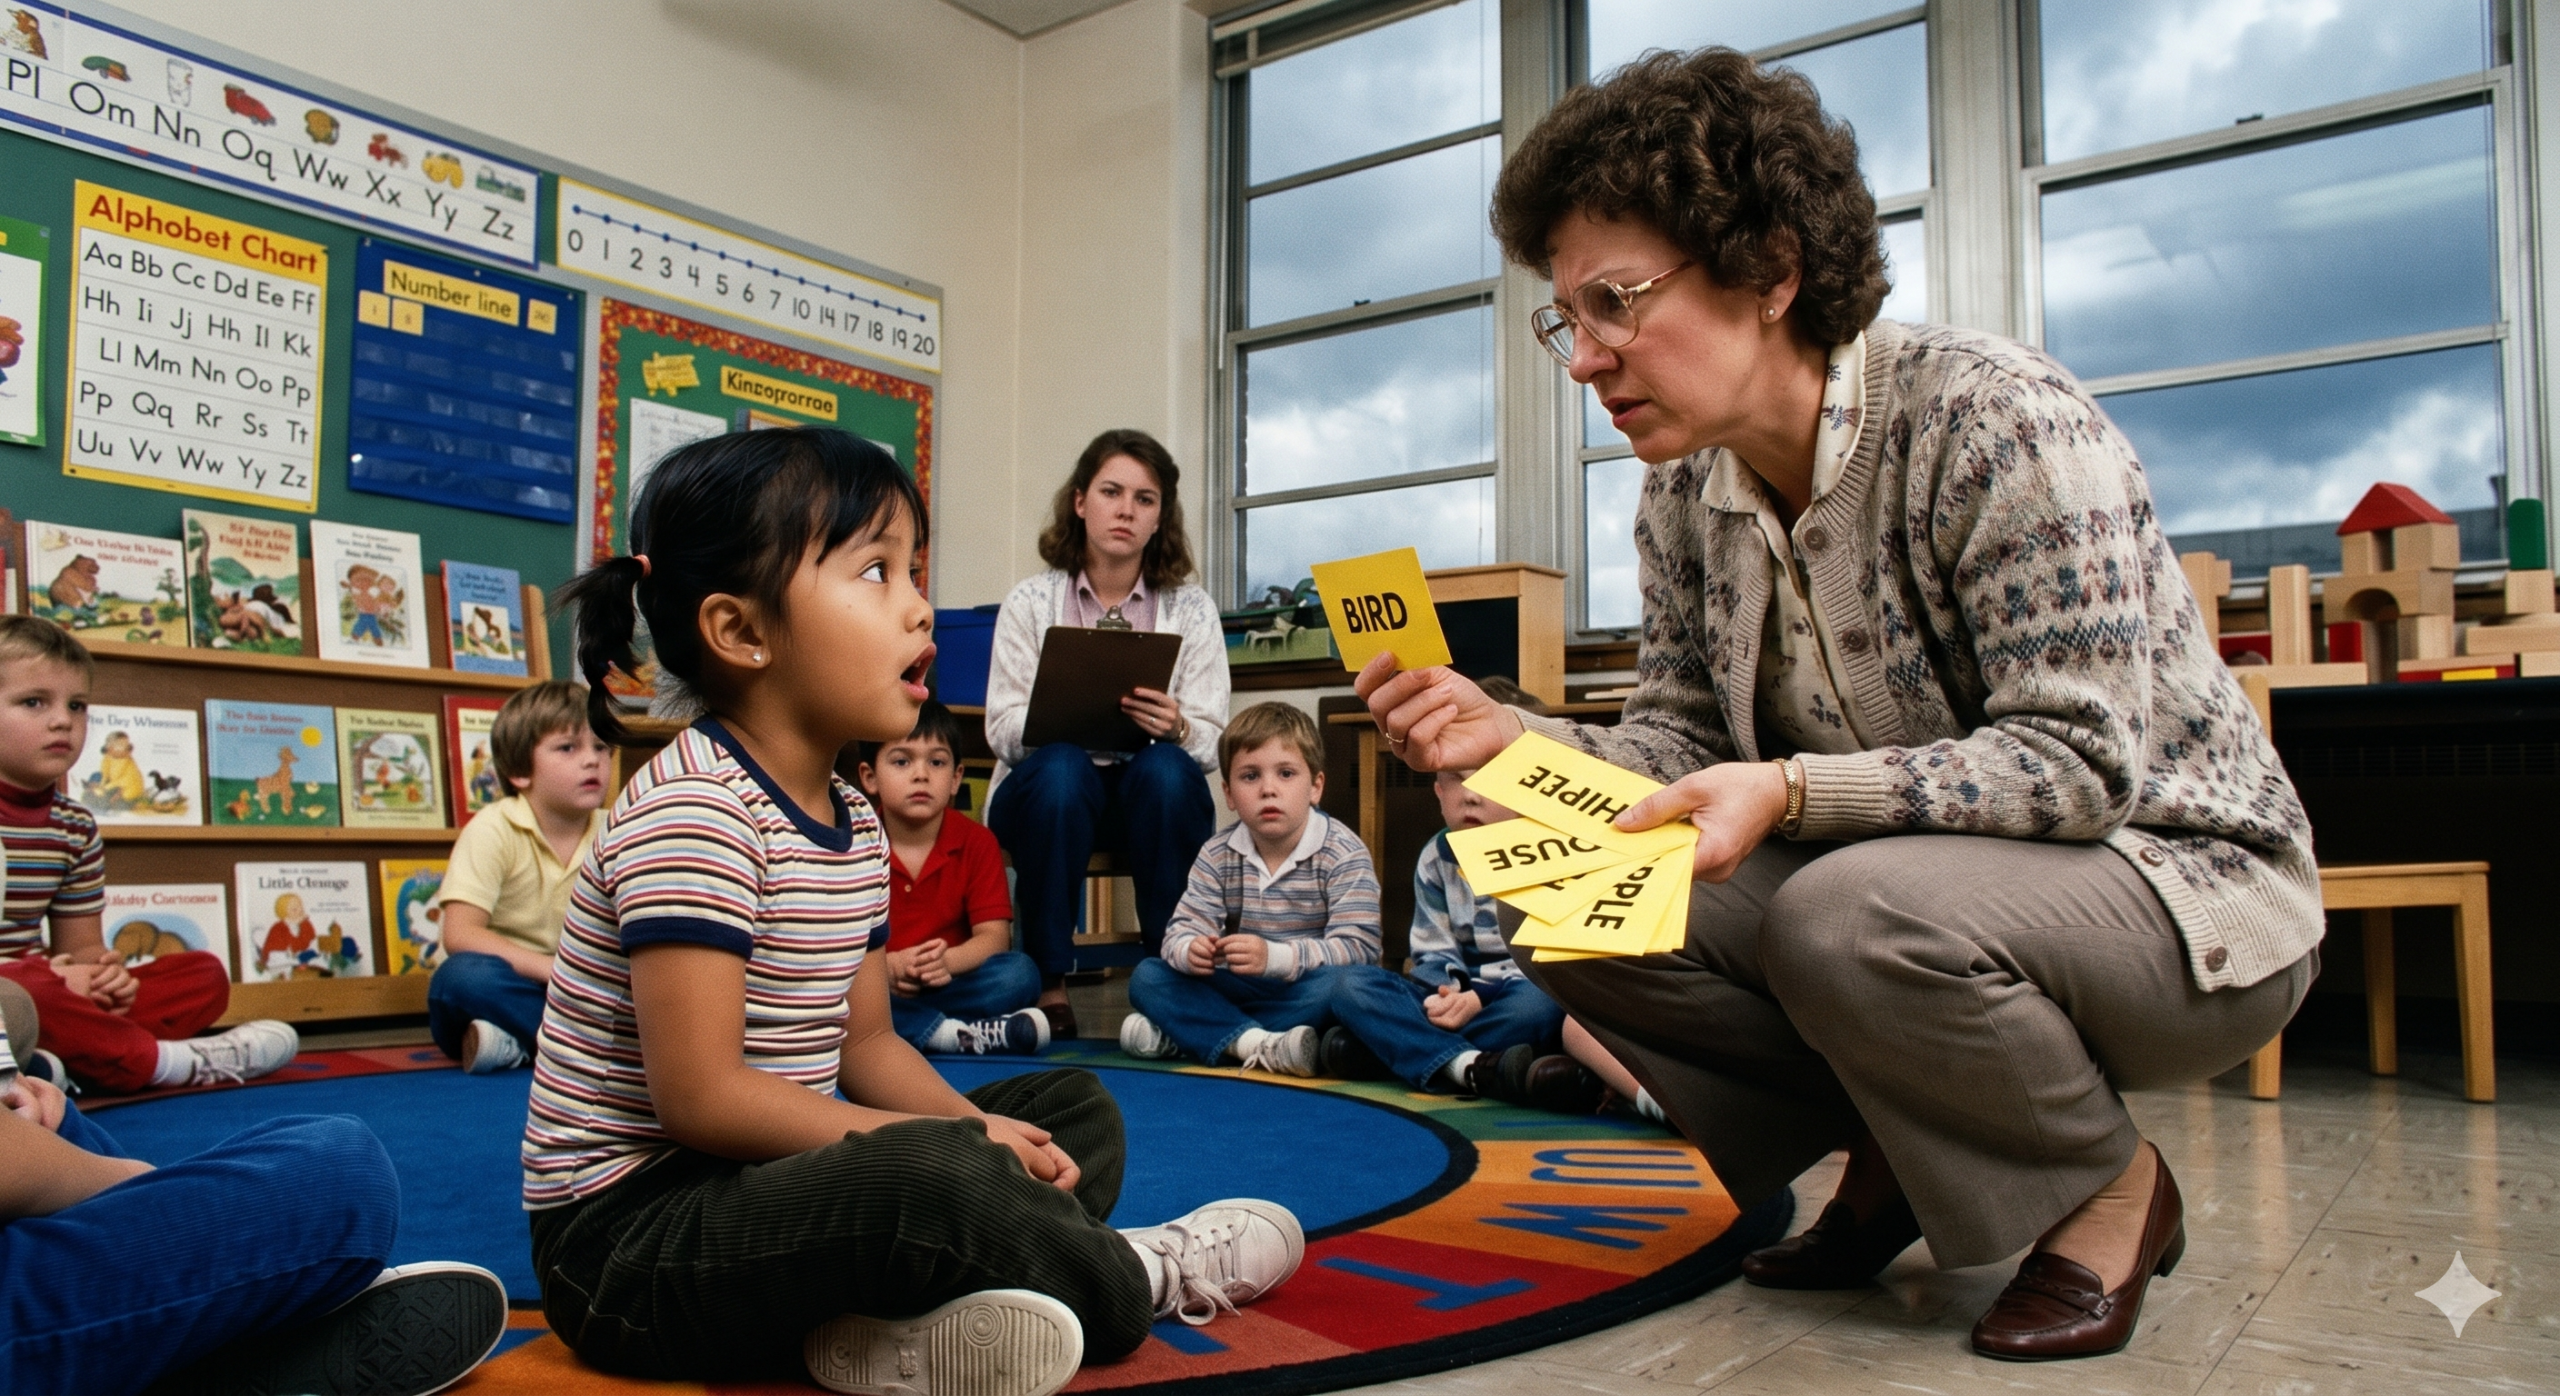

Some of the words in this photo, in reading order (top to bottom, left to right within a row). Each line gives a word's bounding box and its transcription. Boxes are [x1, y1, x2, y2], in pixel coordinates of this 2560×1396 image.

[70, 81, 135, 127] Om
[154, 105, 200, 147] Nn
[222, 129, 276, 181] Oq
[293, 148, 348, 190] Ww
[366, 170, 401, 207] Xx
[426, 188, 457, 231] Yy
[482, 206, 514, 241] Zz
[84, 241, 122, 269] Aa
[131, 249, 163, 278] Bb
[172, 262, 206, 289] Cc
[214, 271, 248, 299] Dd
[257, 281, 285, 307] Ee
[293, 290, 316, 314] Ff
[241, 234, 317, 273] Chart
[85, 286, 120, 316] Hh
[138, 297, 152, 323] Ii
[170, 307, 192, 340] Jj
[208, 314, 240, 342] Hh
[255, 324, 269, 349] Il
[284, 331, 312, 358] Kk
[391, 269, 471, 308] Number
[478, 290, 512, 318] line
[568, 229, 583, 251] 0
[604, 239, 609, 260] 1
[630, 248, 643, 271] 2
[659, 256, 672, 278] 3
[688, 264, 699, 287] 4
[716, 273, 728, 295] 5
[743, 282, 755, 303] 6
[769, 289, 781, 310] 7
[793, 297, 811, 319] 10
[819, 305, 835, 328] 14
[844, 311, 860, 334] 17
[868, 320, 883, 342] 18
[892, 327, 907, 350] 19
[912, 333, 935, 356] 20
[100, 337, 121, 363] Ll
[134, 344, 181, 376] Mm
[192, 356, 225, 384] Nn
[236, 367, 272, 393] Oo
[282, 376, 311, 408] Pp
[80, 381, 113, 415] Pp
[132, 391, 174, 428] Qq
[196, 402, 223, 428] Rr
[242, 412, 268, 438] Ss
[286, 419, 309, 444] Tt
[78, 429, 114, 456] Uu
[129, 437, 162, 464] Vv
[178, 445, 224, 475] Ww
[237, 455, 267, 489] Yy
[279, 463, 308, 489] Zz
[1341, 592, 1408, 634] BIRD
[1584, 857, 1661, 930] PPLE
